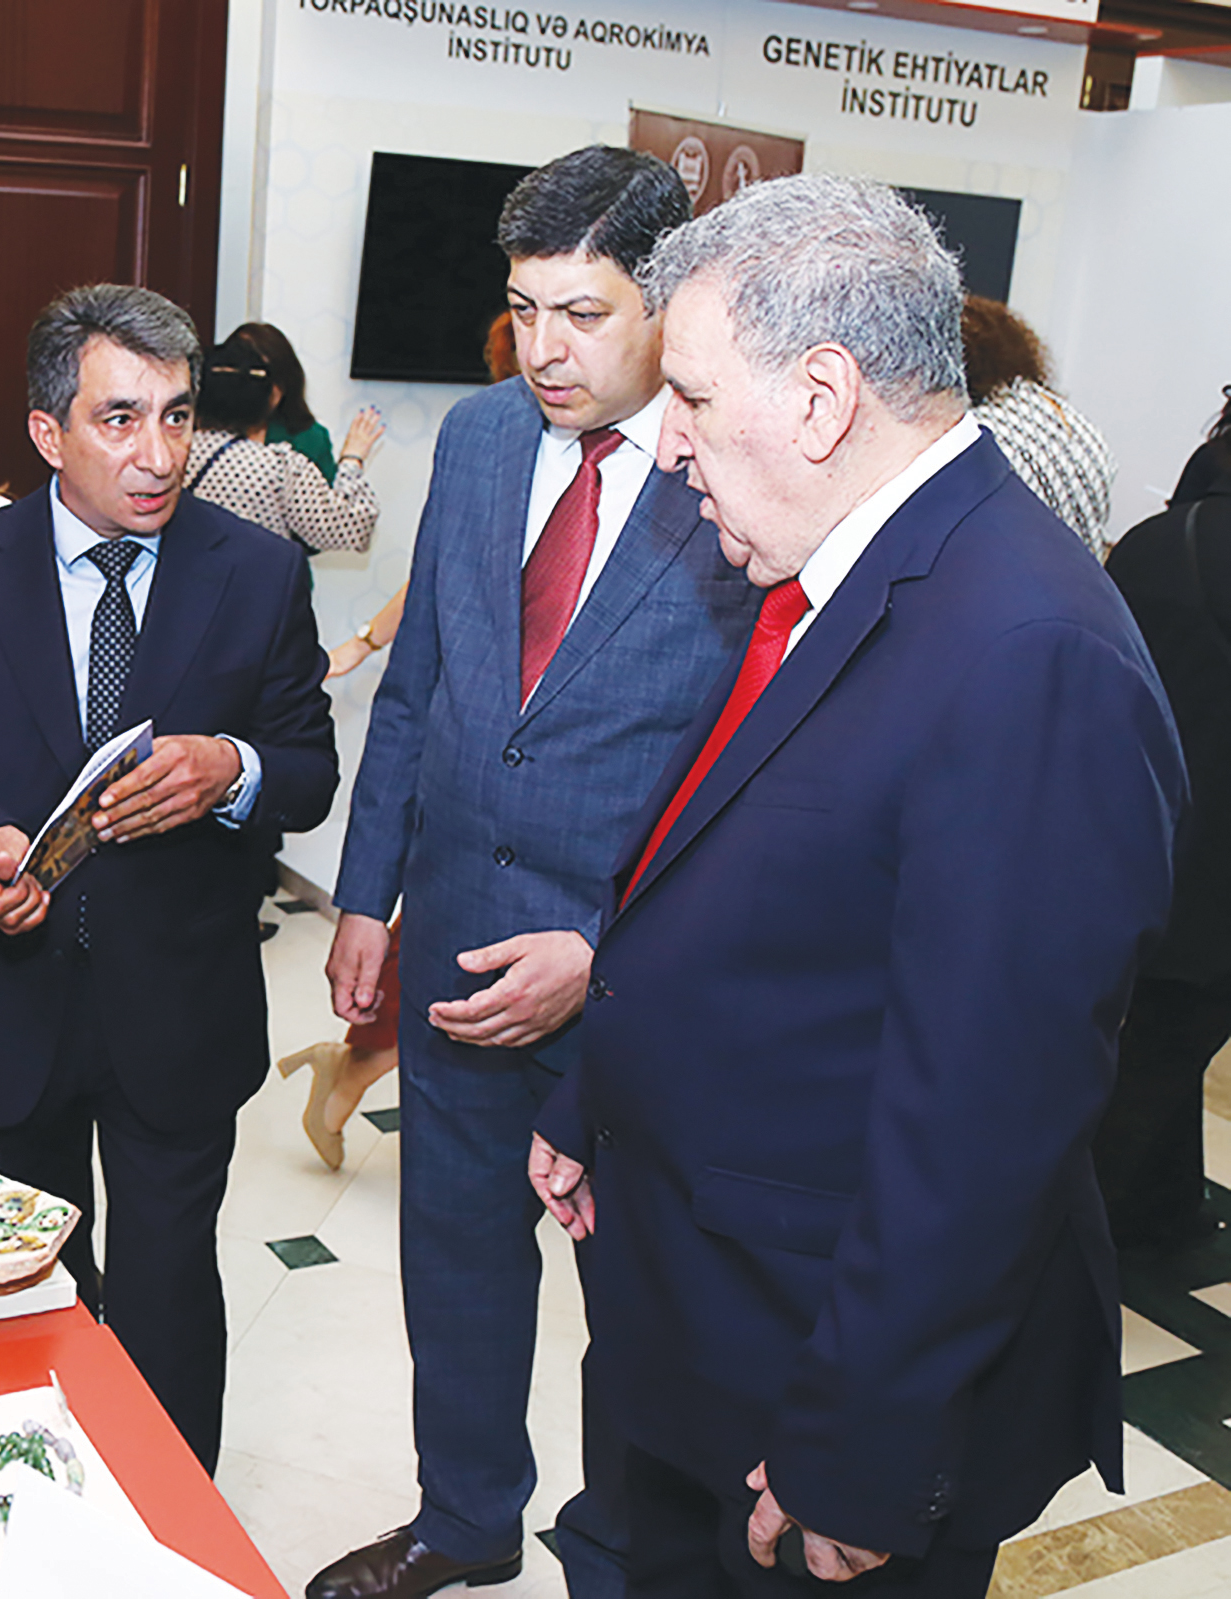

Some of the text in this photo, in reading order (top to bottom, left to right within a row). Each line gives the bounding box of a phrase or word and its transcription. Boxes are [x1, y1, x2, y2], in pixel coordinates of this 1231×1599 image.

[448, 30, 571, 71] İNSTİTUTU
[536, 13, 568, 38] VƏ
[573, 19, 710, 57] AQROKİMYA
[763, 35, 1050, 97] GENETİK EHTİYATLAR
[841, 78, 978, 127] İNSTİTUTU
